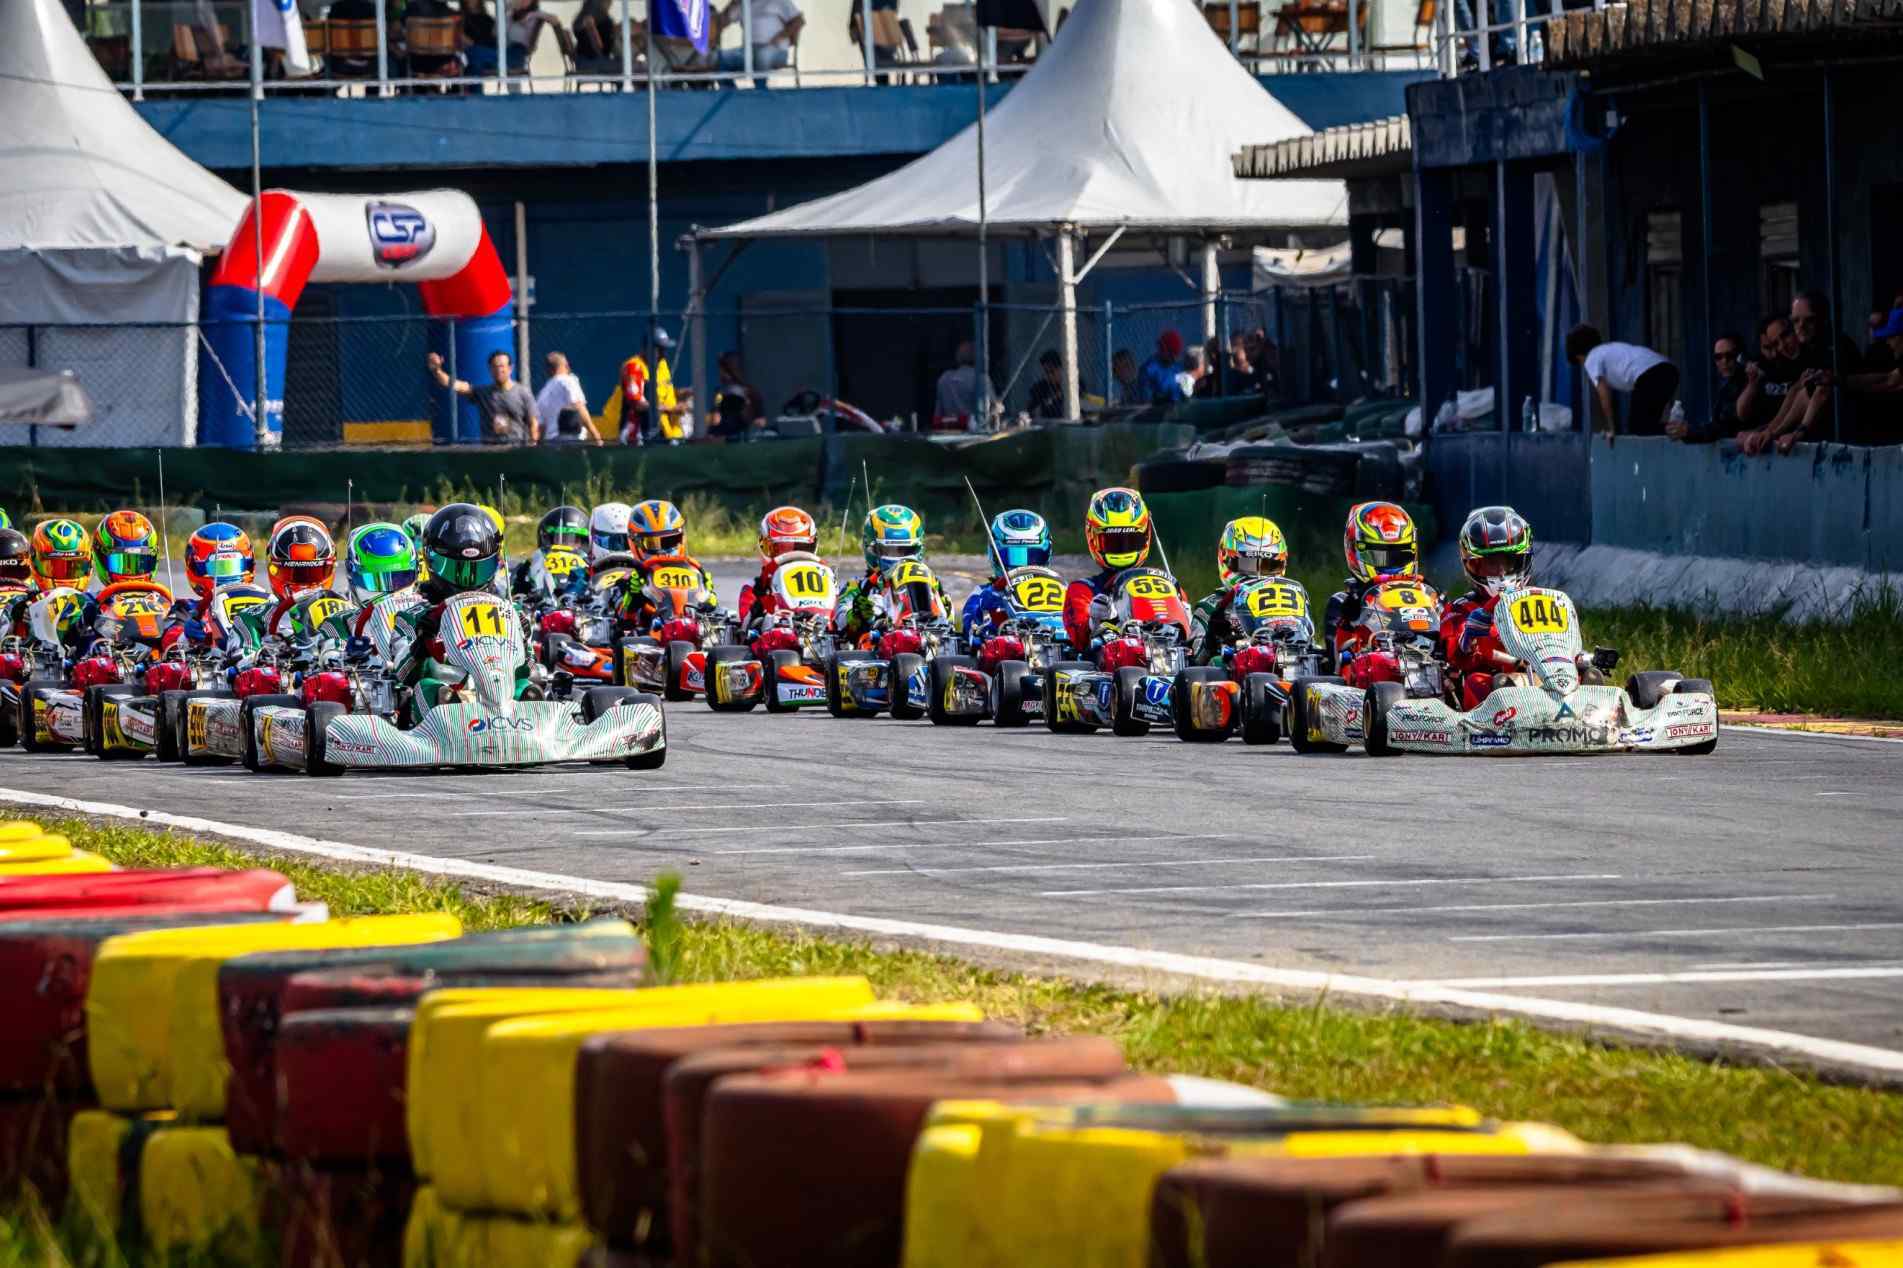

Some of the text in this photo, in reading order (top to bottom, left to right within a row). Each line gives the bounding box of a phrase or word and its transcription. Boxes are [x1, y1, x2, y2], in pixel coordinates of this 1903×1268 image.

[791, 571, 824, 593] 10
[1134, 578, 1171, 594] 55
[1027, 582, 1063, 607] 22
[1259, 587, 1299, 611] 23
[466, 606, 502, 635] 11
[1520, 599, 1563, 628] 444
